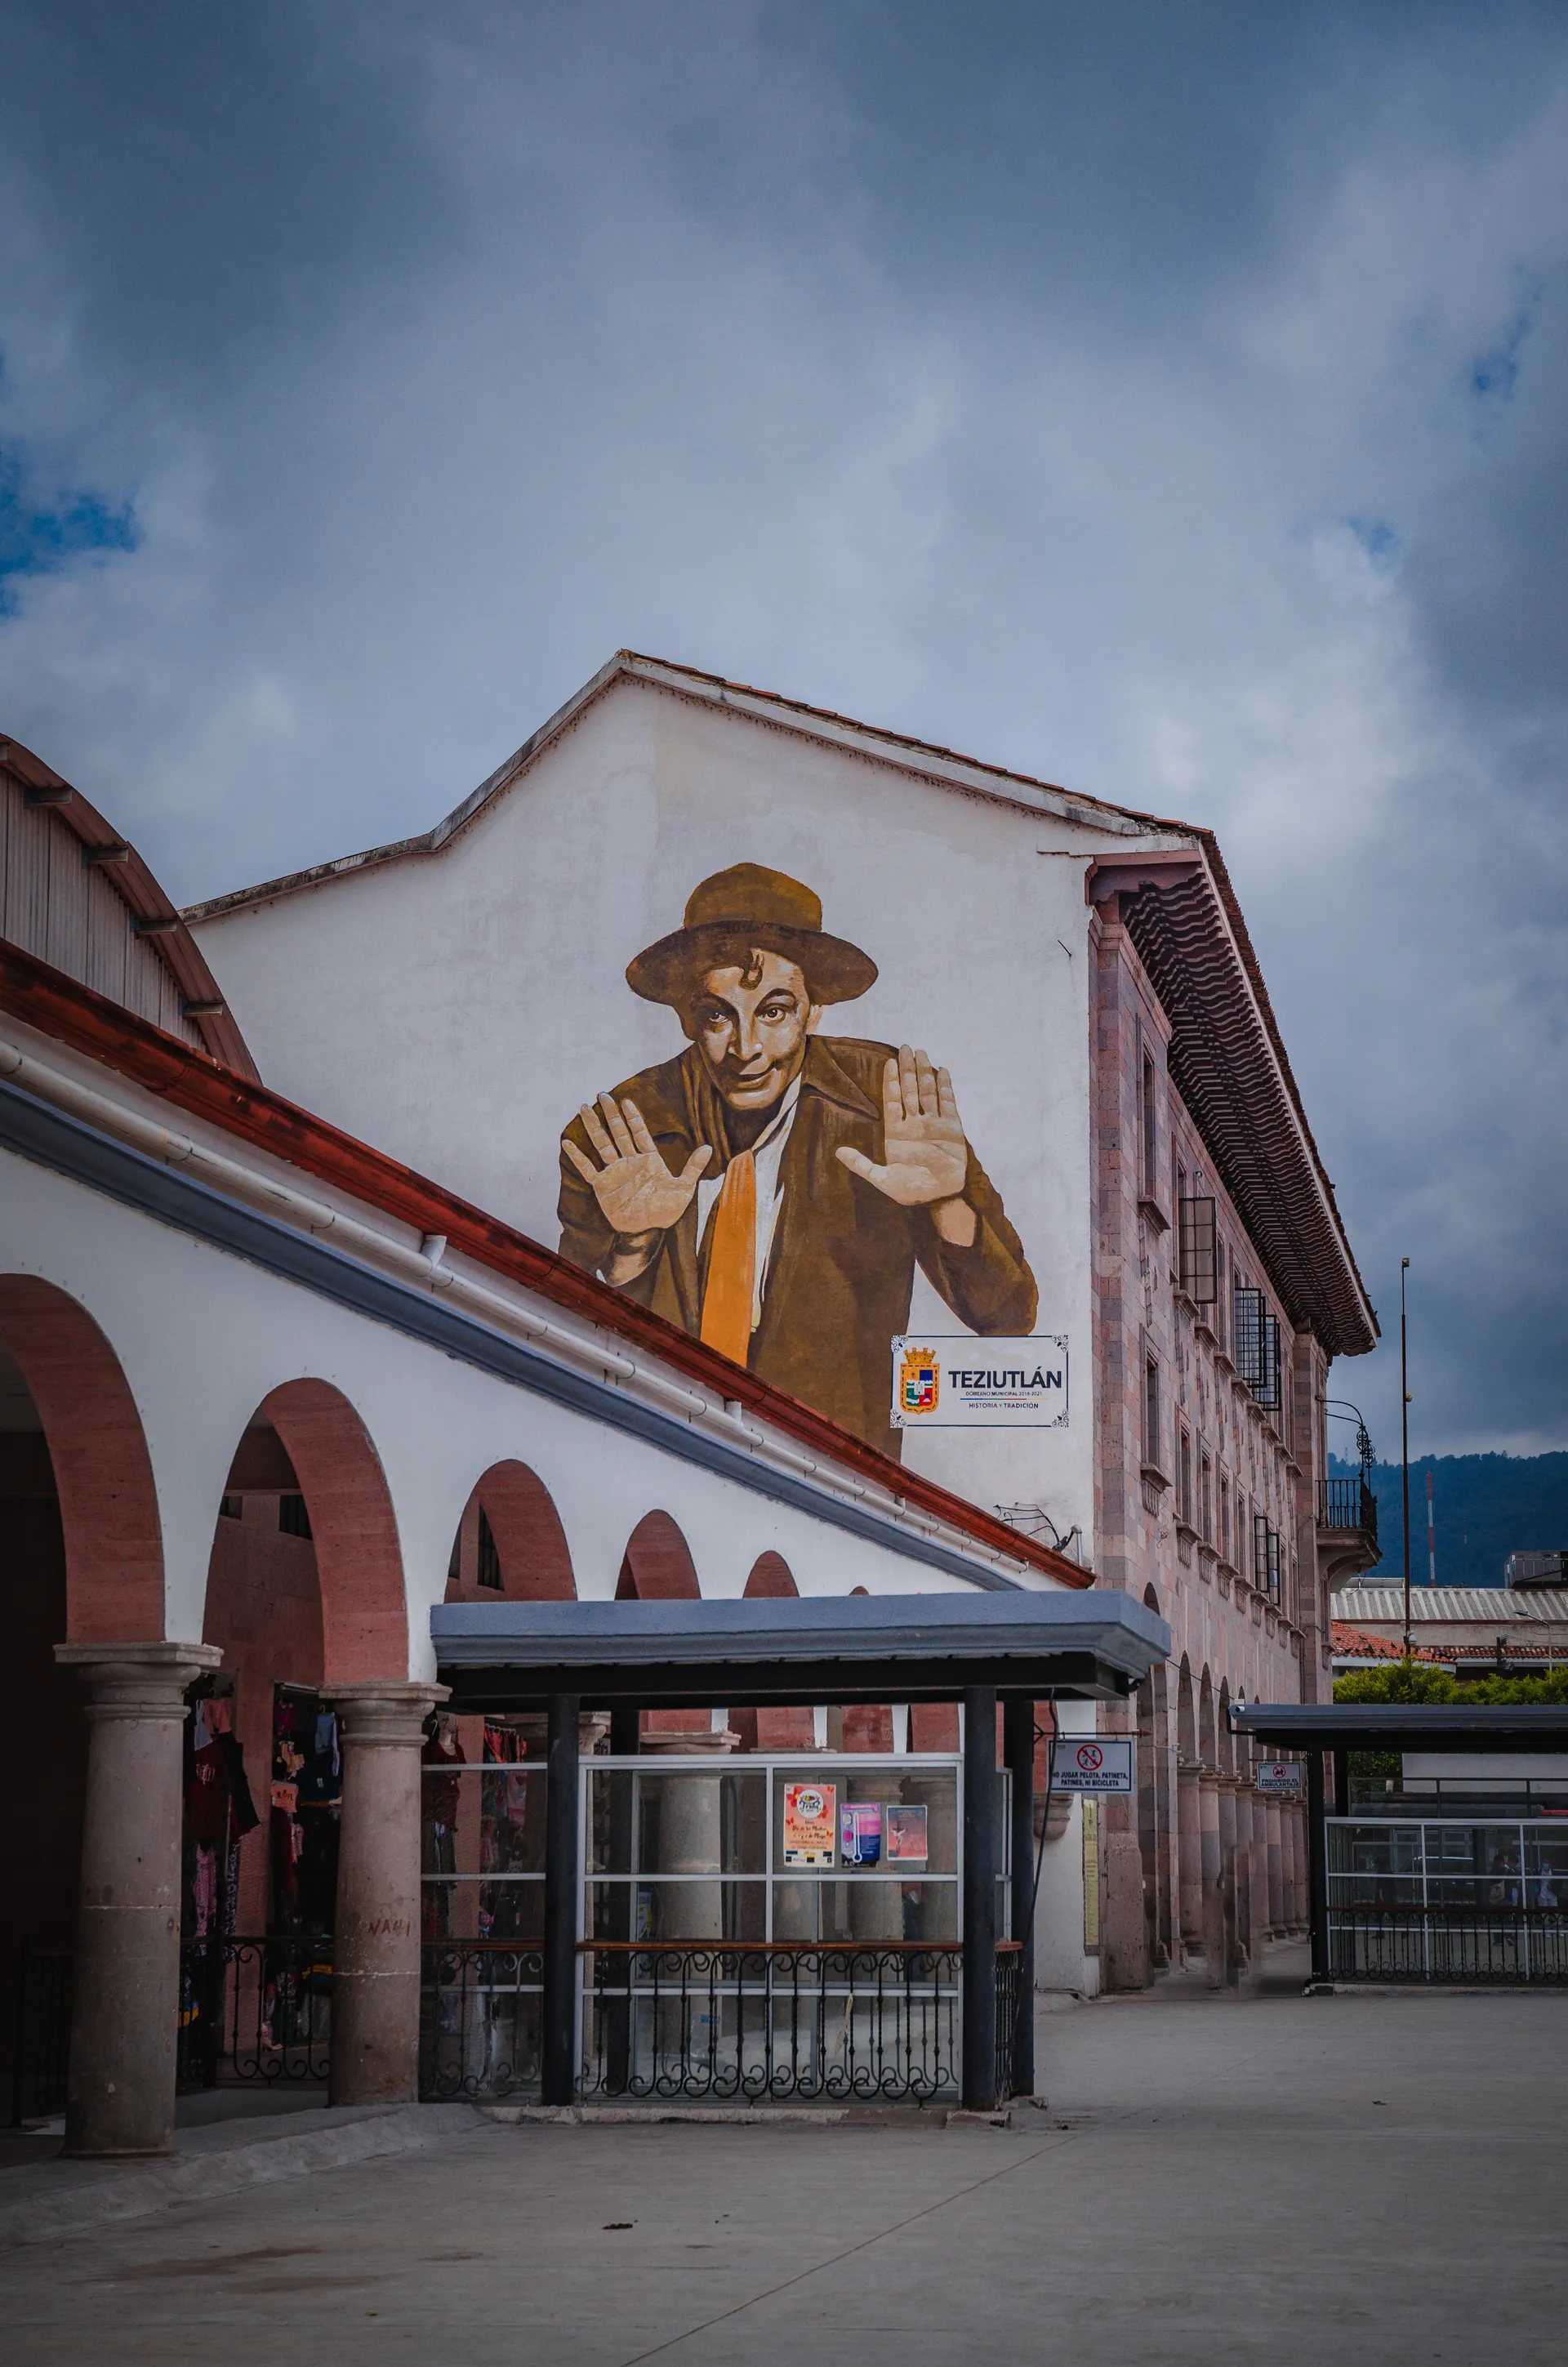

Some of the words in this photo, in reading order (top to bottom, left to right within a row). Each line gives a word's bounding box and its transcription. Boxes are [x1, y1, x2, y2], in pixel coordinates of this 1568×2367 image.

[947, 1366, 1062, 1389] TEZIUTLÁN
[1004, 1401, 1039, 1409] TRADICIÓN
[1102, 1772, 1129, 1780] PATINETA,
